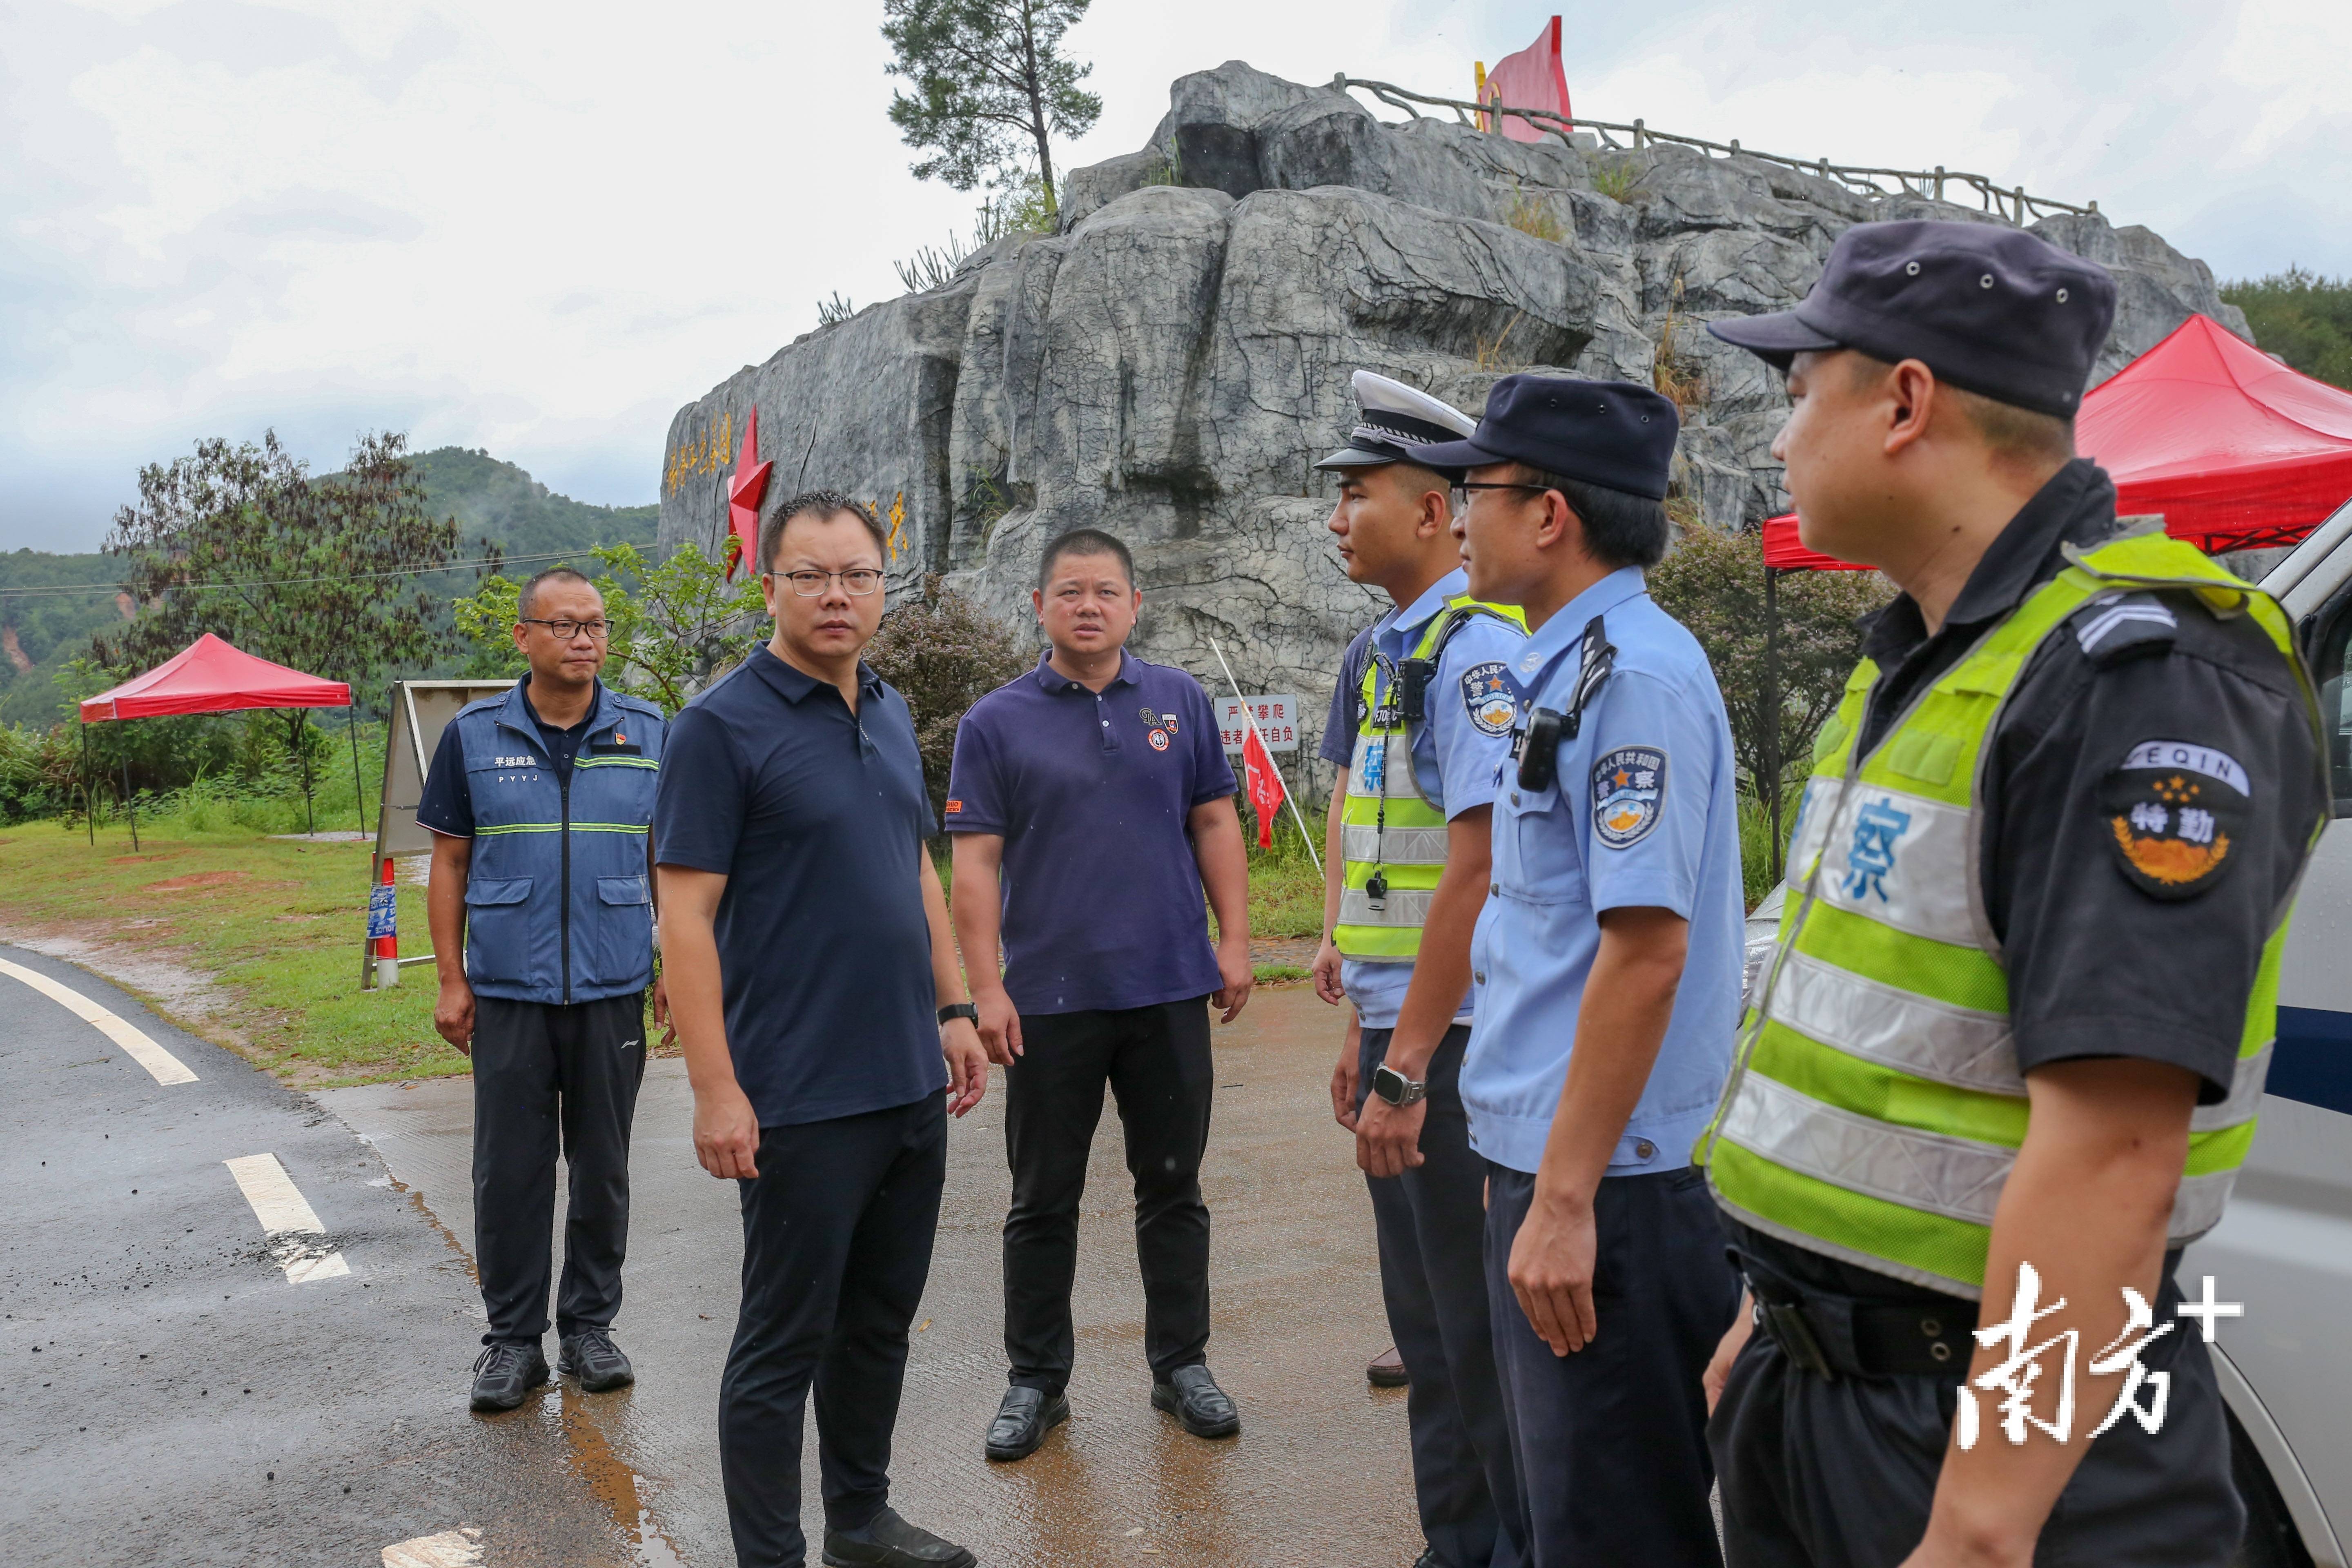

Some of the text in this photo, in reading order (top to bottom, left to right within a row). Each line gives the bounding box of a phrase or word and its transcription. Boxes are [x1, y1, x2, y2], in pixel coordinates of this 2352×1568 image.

[1484, 693, 1510, 702] POLICE
[1228, 704, 1283, 721] 严攀爬
[1221, 726, 1293, 745] 违者任自负
[494, 755, 537, 767] 平远应急
[1595, 751, 1661, 782] 中华人民共和国
[2130, 802, 2215, 843] 特勤
